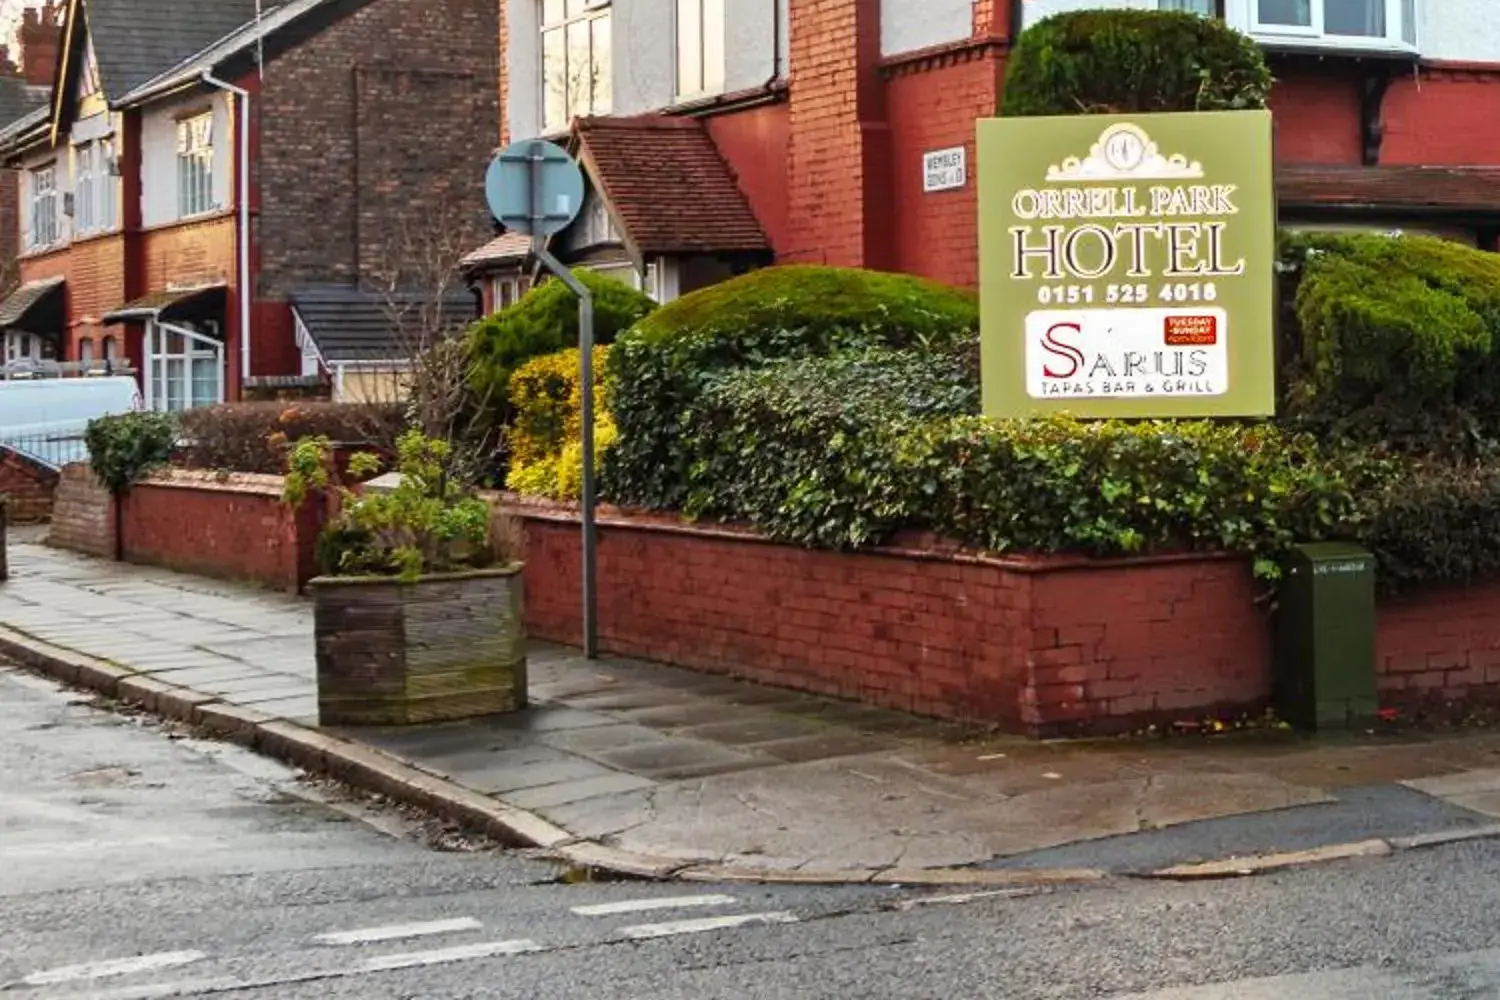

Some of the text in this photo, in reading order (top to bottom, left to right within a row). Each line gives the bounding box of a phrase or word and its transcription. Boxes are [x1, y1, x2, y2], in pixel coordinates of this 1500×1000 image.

[1012, 183, 1240, 219] ORRELL PARK
[1008, 221, 1246, 279] HOTEL
[1038, 285, 1094, 304] 0151
[1105, 284, 1149, 303] 525
[1041, 381, 1095, 395] TAPAS
[1103, 381, 1136, 394] BAR
[1162, 379, 1213, 393] GRILL
